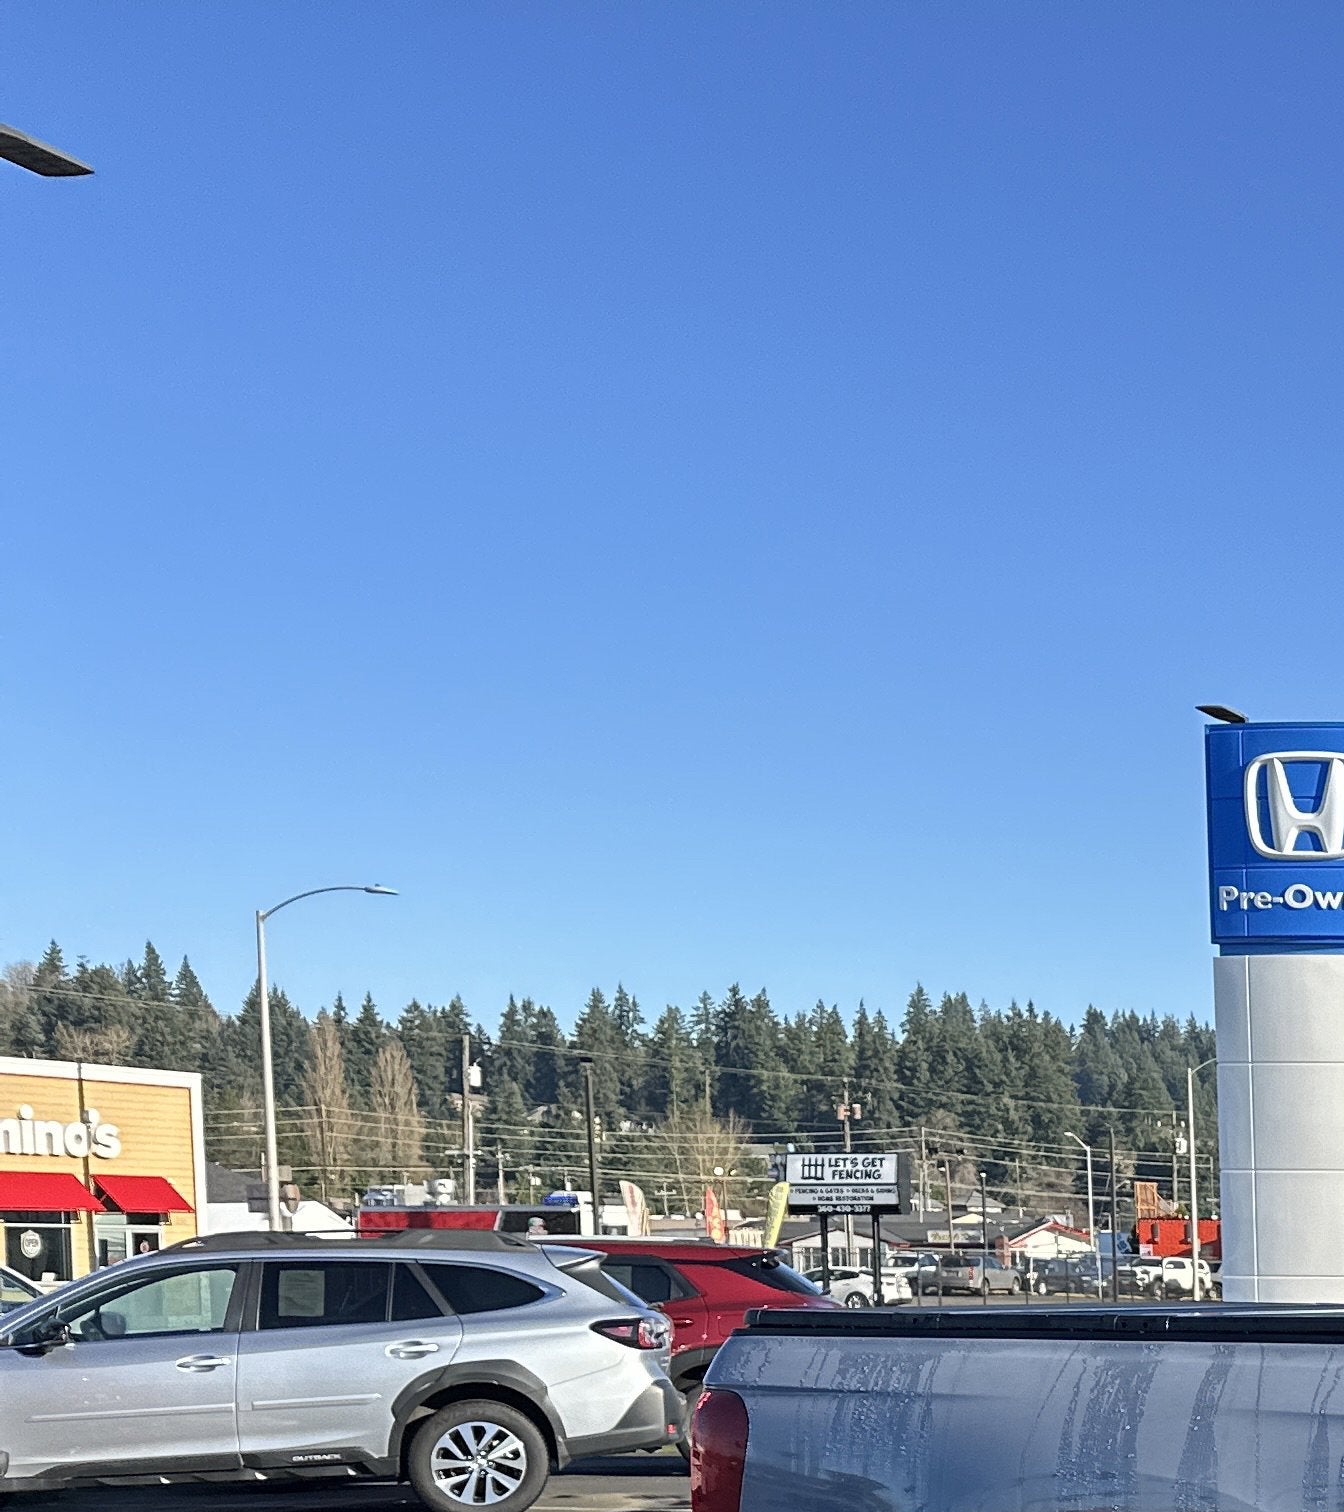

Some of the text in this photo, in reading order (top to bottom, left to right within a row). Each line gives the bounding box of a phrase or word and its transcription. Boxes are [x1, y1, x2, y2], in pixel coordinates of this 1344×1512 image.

[828, 1157, 886, 1168] LET'S GET
[832, 1169, 882, 1180] FENCING
[292, 1453, 342, 1462] OUTBACK
